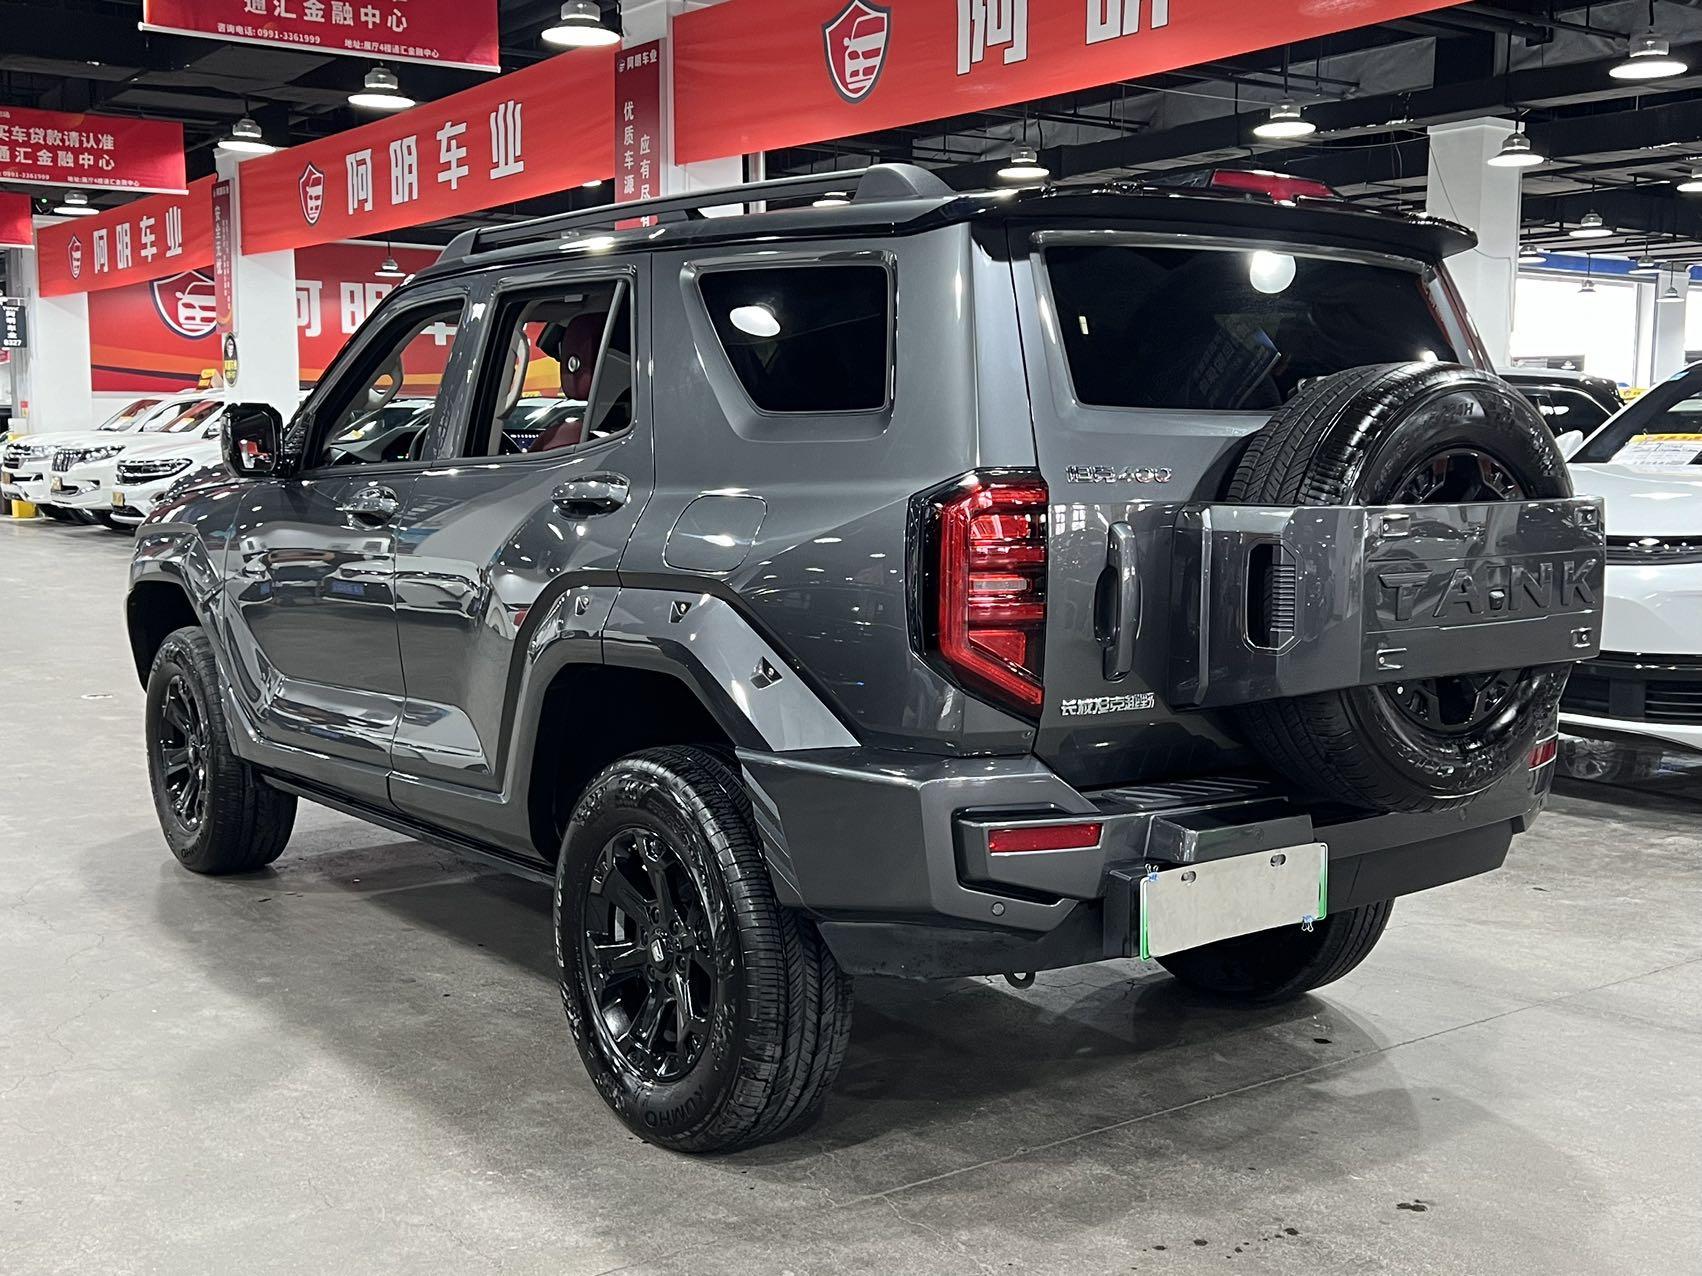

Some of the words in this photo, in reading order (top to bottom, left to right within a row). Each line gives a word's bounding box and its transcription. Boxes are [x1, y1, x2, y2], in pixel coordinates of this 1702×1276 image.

[243, 0, 408, 33] 通汇金融中心
[0, 125, 115, 150] 买车贷款请认准
[346, 100, 525, 216] 阿明车业
[623, 101, 635, 195] 优质车源
[93, 206, 183, 275] 阿明车业
[1378, 559, 1599, 621] TANK
